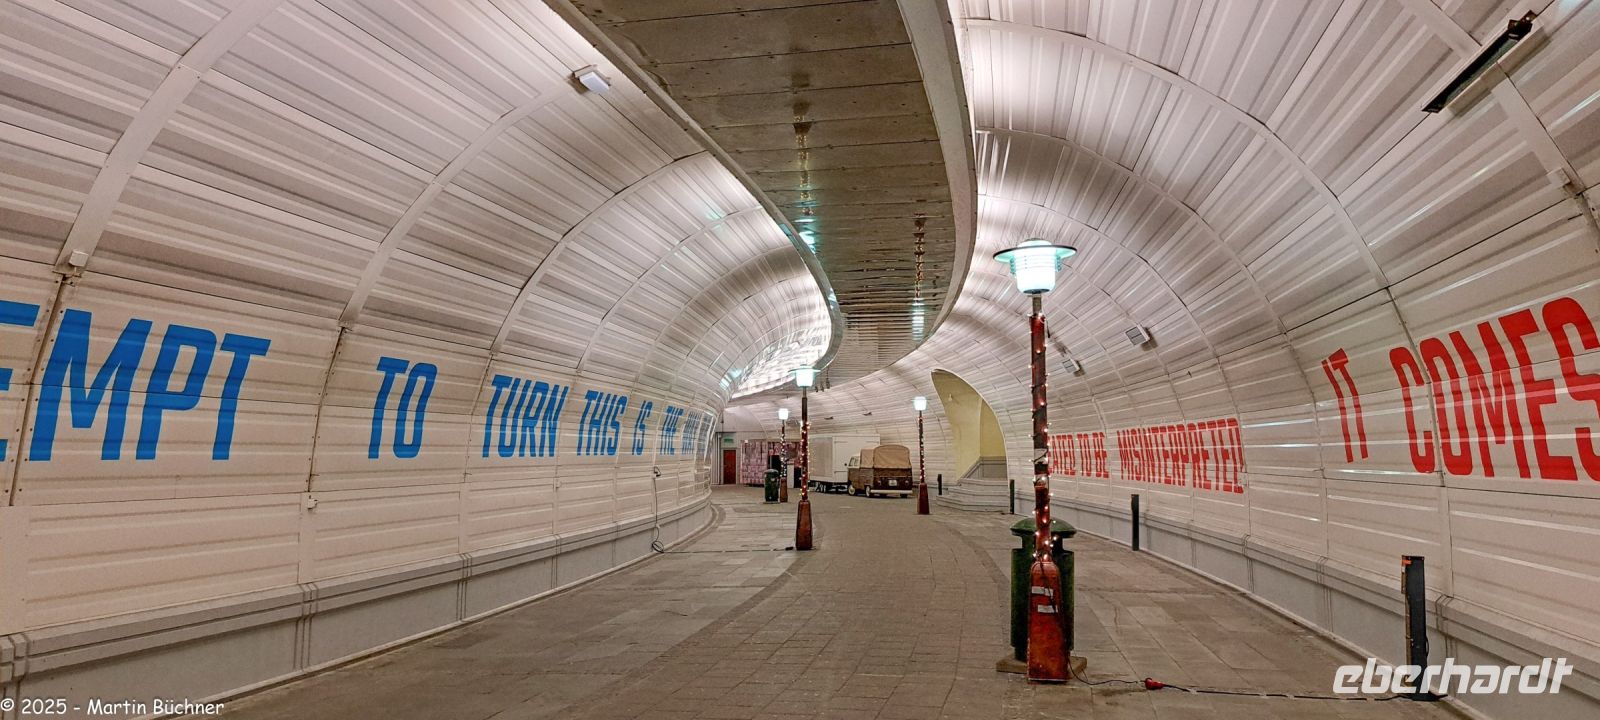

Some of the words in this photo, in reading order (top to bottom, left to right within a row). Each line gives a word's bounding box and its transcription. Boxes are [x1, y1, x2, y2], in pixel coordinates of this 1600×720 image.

[368, 356, 438, 459] TO
[482, 374, 568, 458] TURN
[577, 390, 627, 456] THIS
[632, 400, 653, 455] IS
[660, 406, 684, 455] THE
[1077, 433, 1091, 477] TO
[1092, 431, 1109, 478] BE
[1117, 417, 1244, 494] MISINTERPRETED
[1321, 348, 1368, 463] IT
[1389, 297, 1600, 481] COMES
